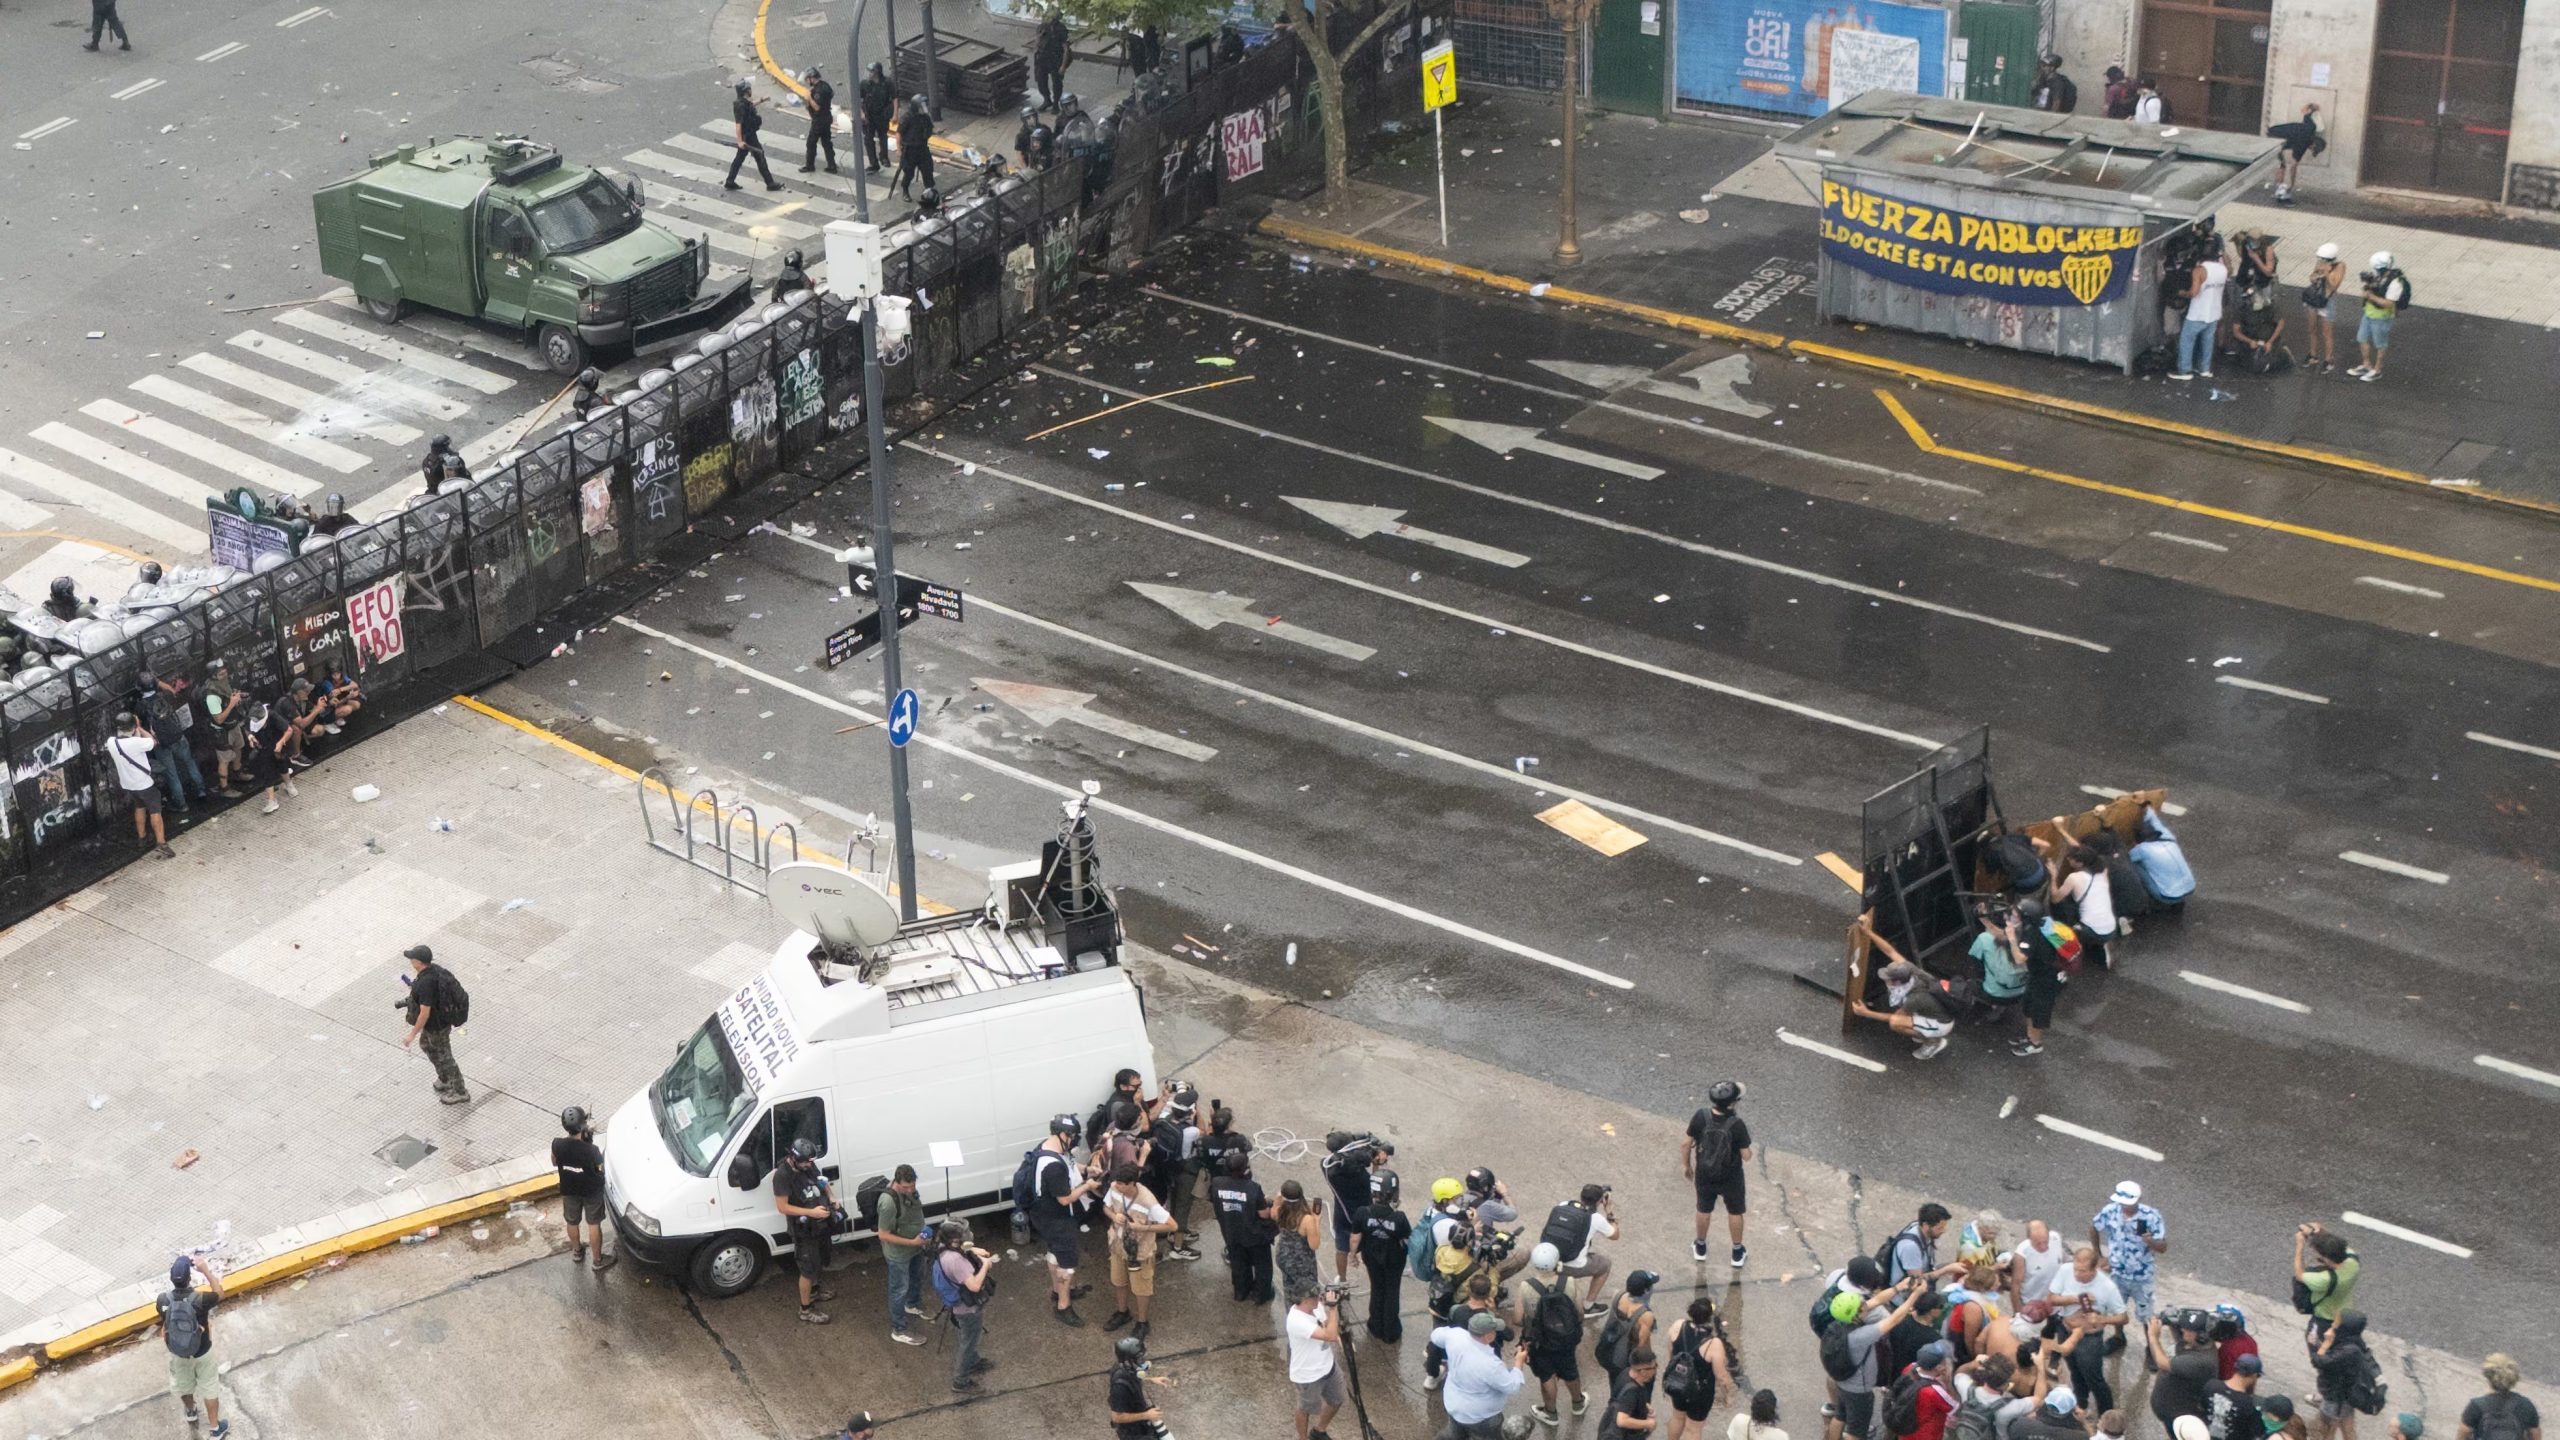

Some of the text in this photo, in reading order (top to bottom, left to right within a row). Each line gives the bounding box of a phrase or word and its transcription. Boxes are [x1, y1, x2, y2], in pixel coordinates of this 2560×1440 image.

[1823, 179, 1954, 245] FUERZA
[1836, 225, 1905, 264] DOCKE
[1907, 248, 1966, 280] ESTA
[1969, 263, 2014, 286] CON
[2018, 268, 2062, 289] VOS
[1712, 267, 1786, 312] Gracias
[350, 584, 395, 634] EFO
[917, 602, 959, 620] 1800 1700
[920, 593, 960, 610] Rivadavia
[926, 585, 959, 600] Avenida
[283, 610, 341, 640] EL MIEDO
[829, 628, 856, 647] Avenida
[829, 642, 848, 656] Entre
[735, 986, 785, 1079] SATELITAL
[752, 974, 800, 1063] UNIDAD MOVIL
[719, 1006, 766, 1094] TELEVISION
